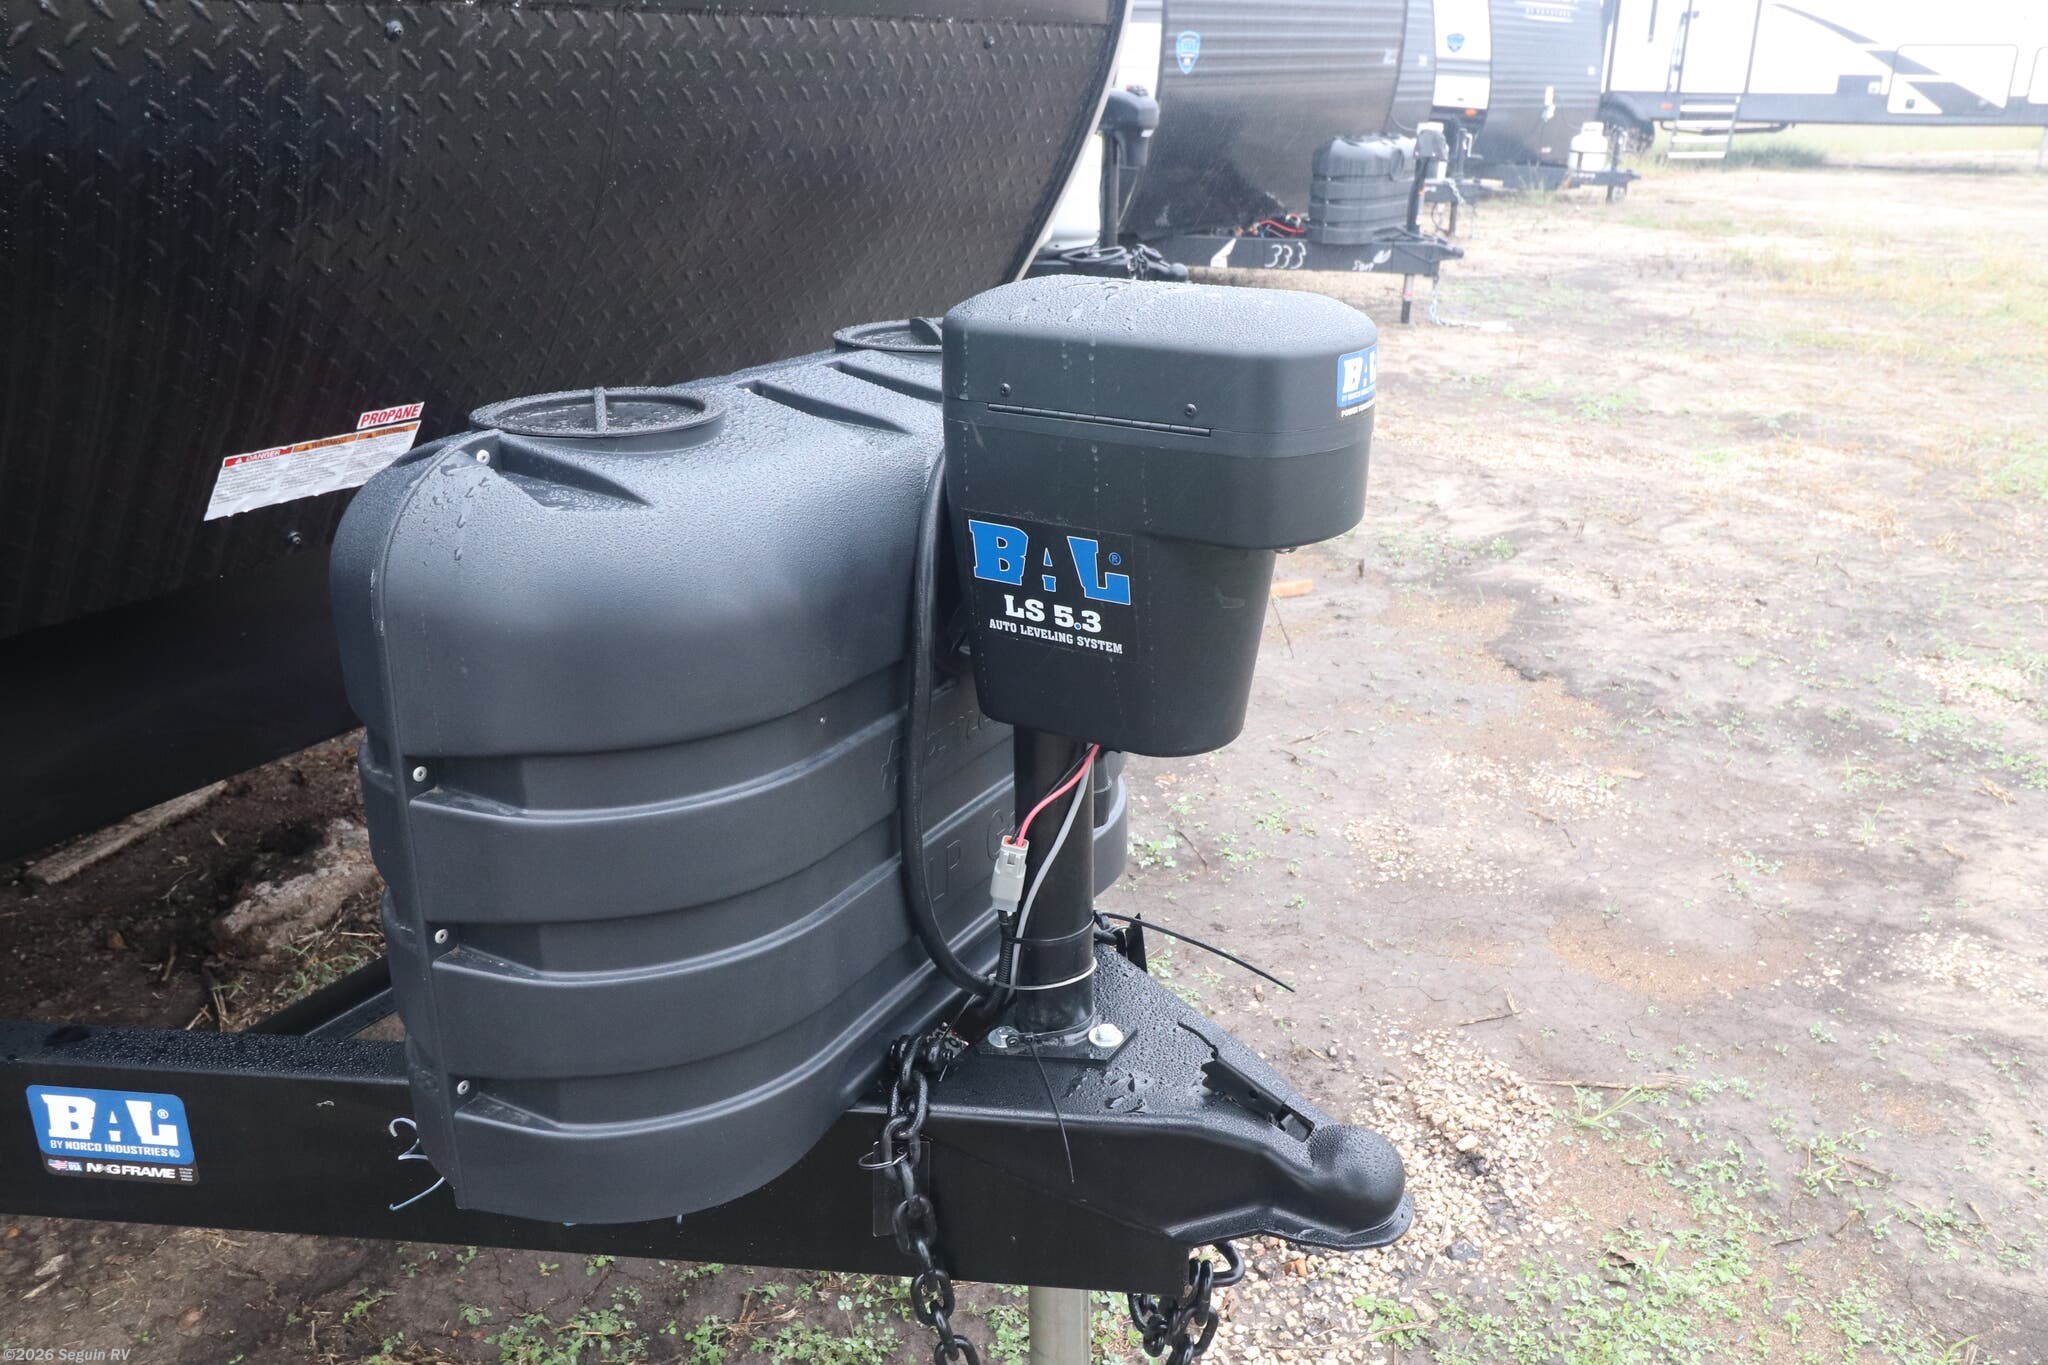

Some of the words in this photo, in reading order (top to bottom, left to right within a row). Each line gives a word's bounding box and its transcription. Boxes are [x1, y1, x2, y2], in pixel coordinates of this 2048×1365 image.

[360, 405, 420, 427] PROPANE
[246, 450, 281, 462] DANGER
[1004, 594, 1046, 622] LS
[1053, 604, 1102, 633] 5.3
[989, 618, 1018, 633] AUTO
[1020, 624, 1074, 645] LEVELING
[1077, 636, 1123, 655] SYSTEM
[50, 1140, 63, 1150] BY
[65, 1141, 103, 1153] NORCO
[104, 1144, 168, 1158] INDUSTRIES
